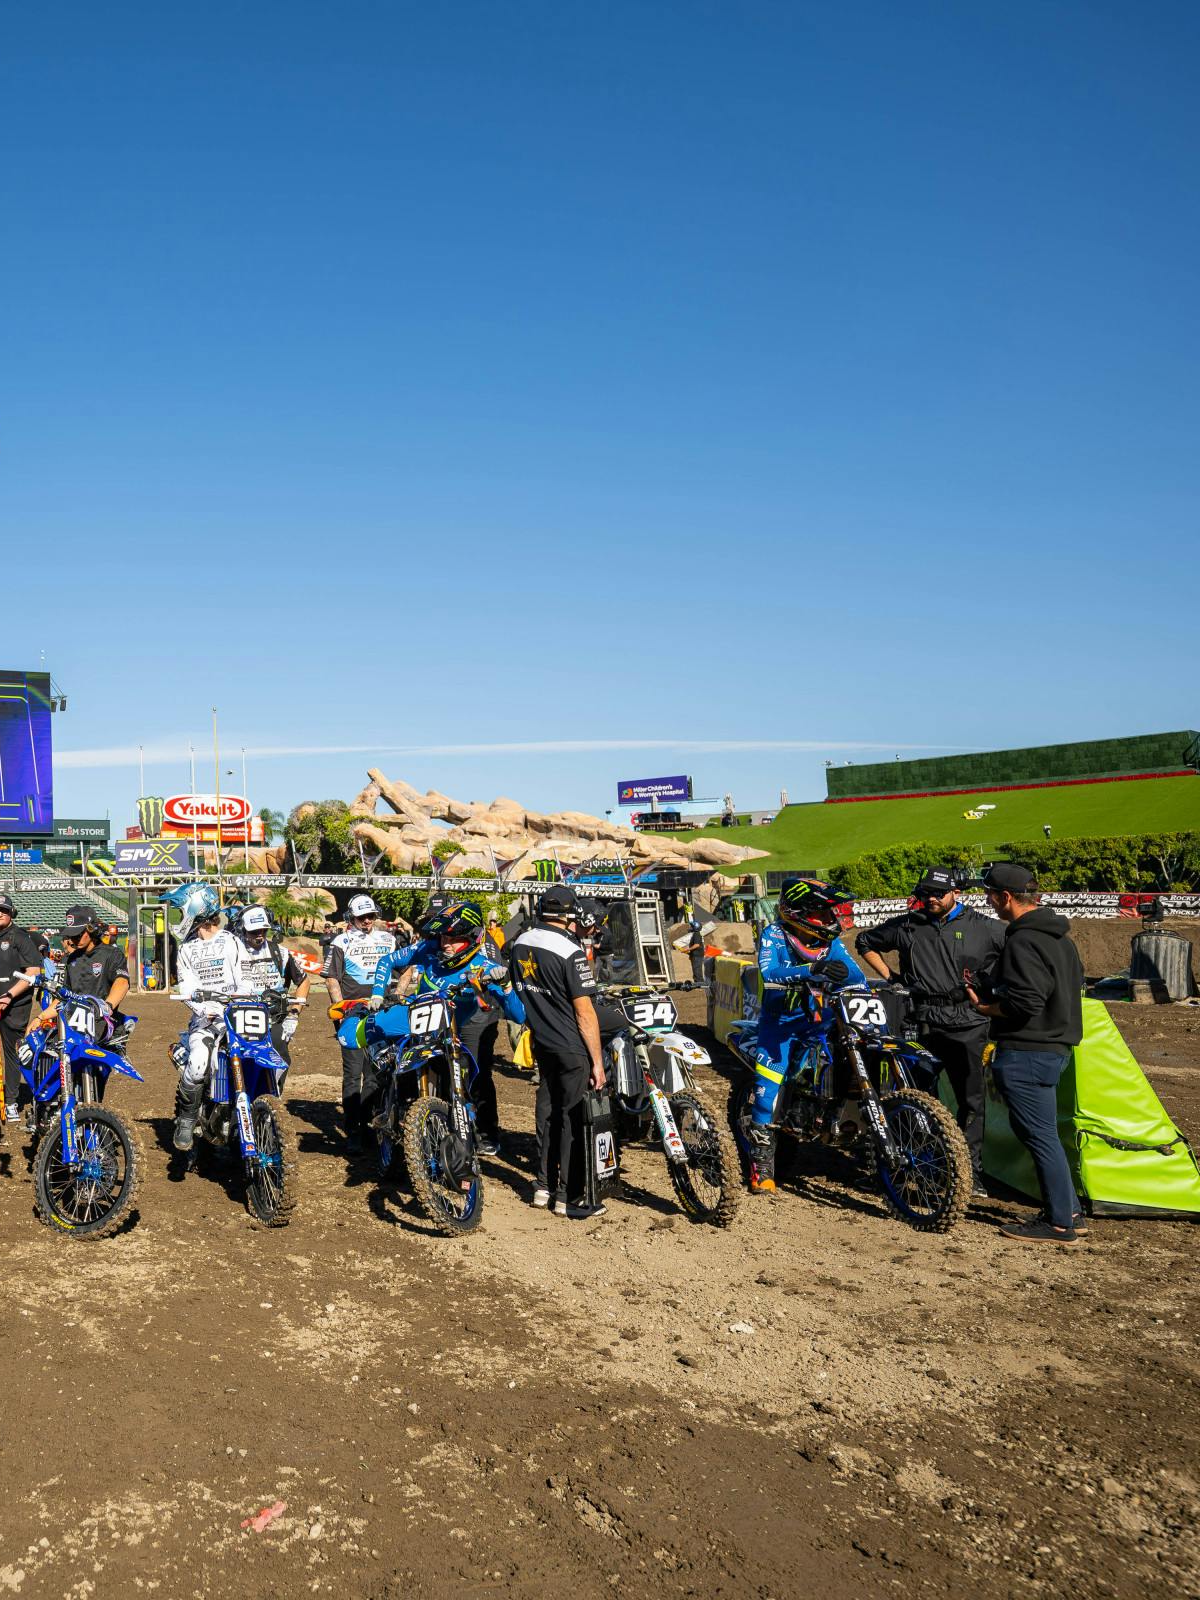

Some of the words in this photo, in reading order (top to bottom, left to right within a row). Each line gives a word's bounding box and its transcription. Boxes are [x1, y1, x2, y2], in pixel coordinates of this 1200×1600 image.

[178, 802, 238, 816] Yakult
[80, 828, 105, 836] STORE
[119, 843, 180, 866] SMX
[879, 898, 907, 906] MOUNTAIN
[68, 1006, 96, 1037] 40
[232, 1010, 266, 1035] 19
[410, 1003, 444, 1035] 61
[633, 1003, 675, 1026] 34
[849, 999, 887, 1026] 23
